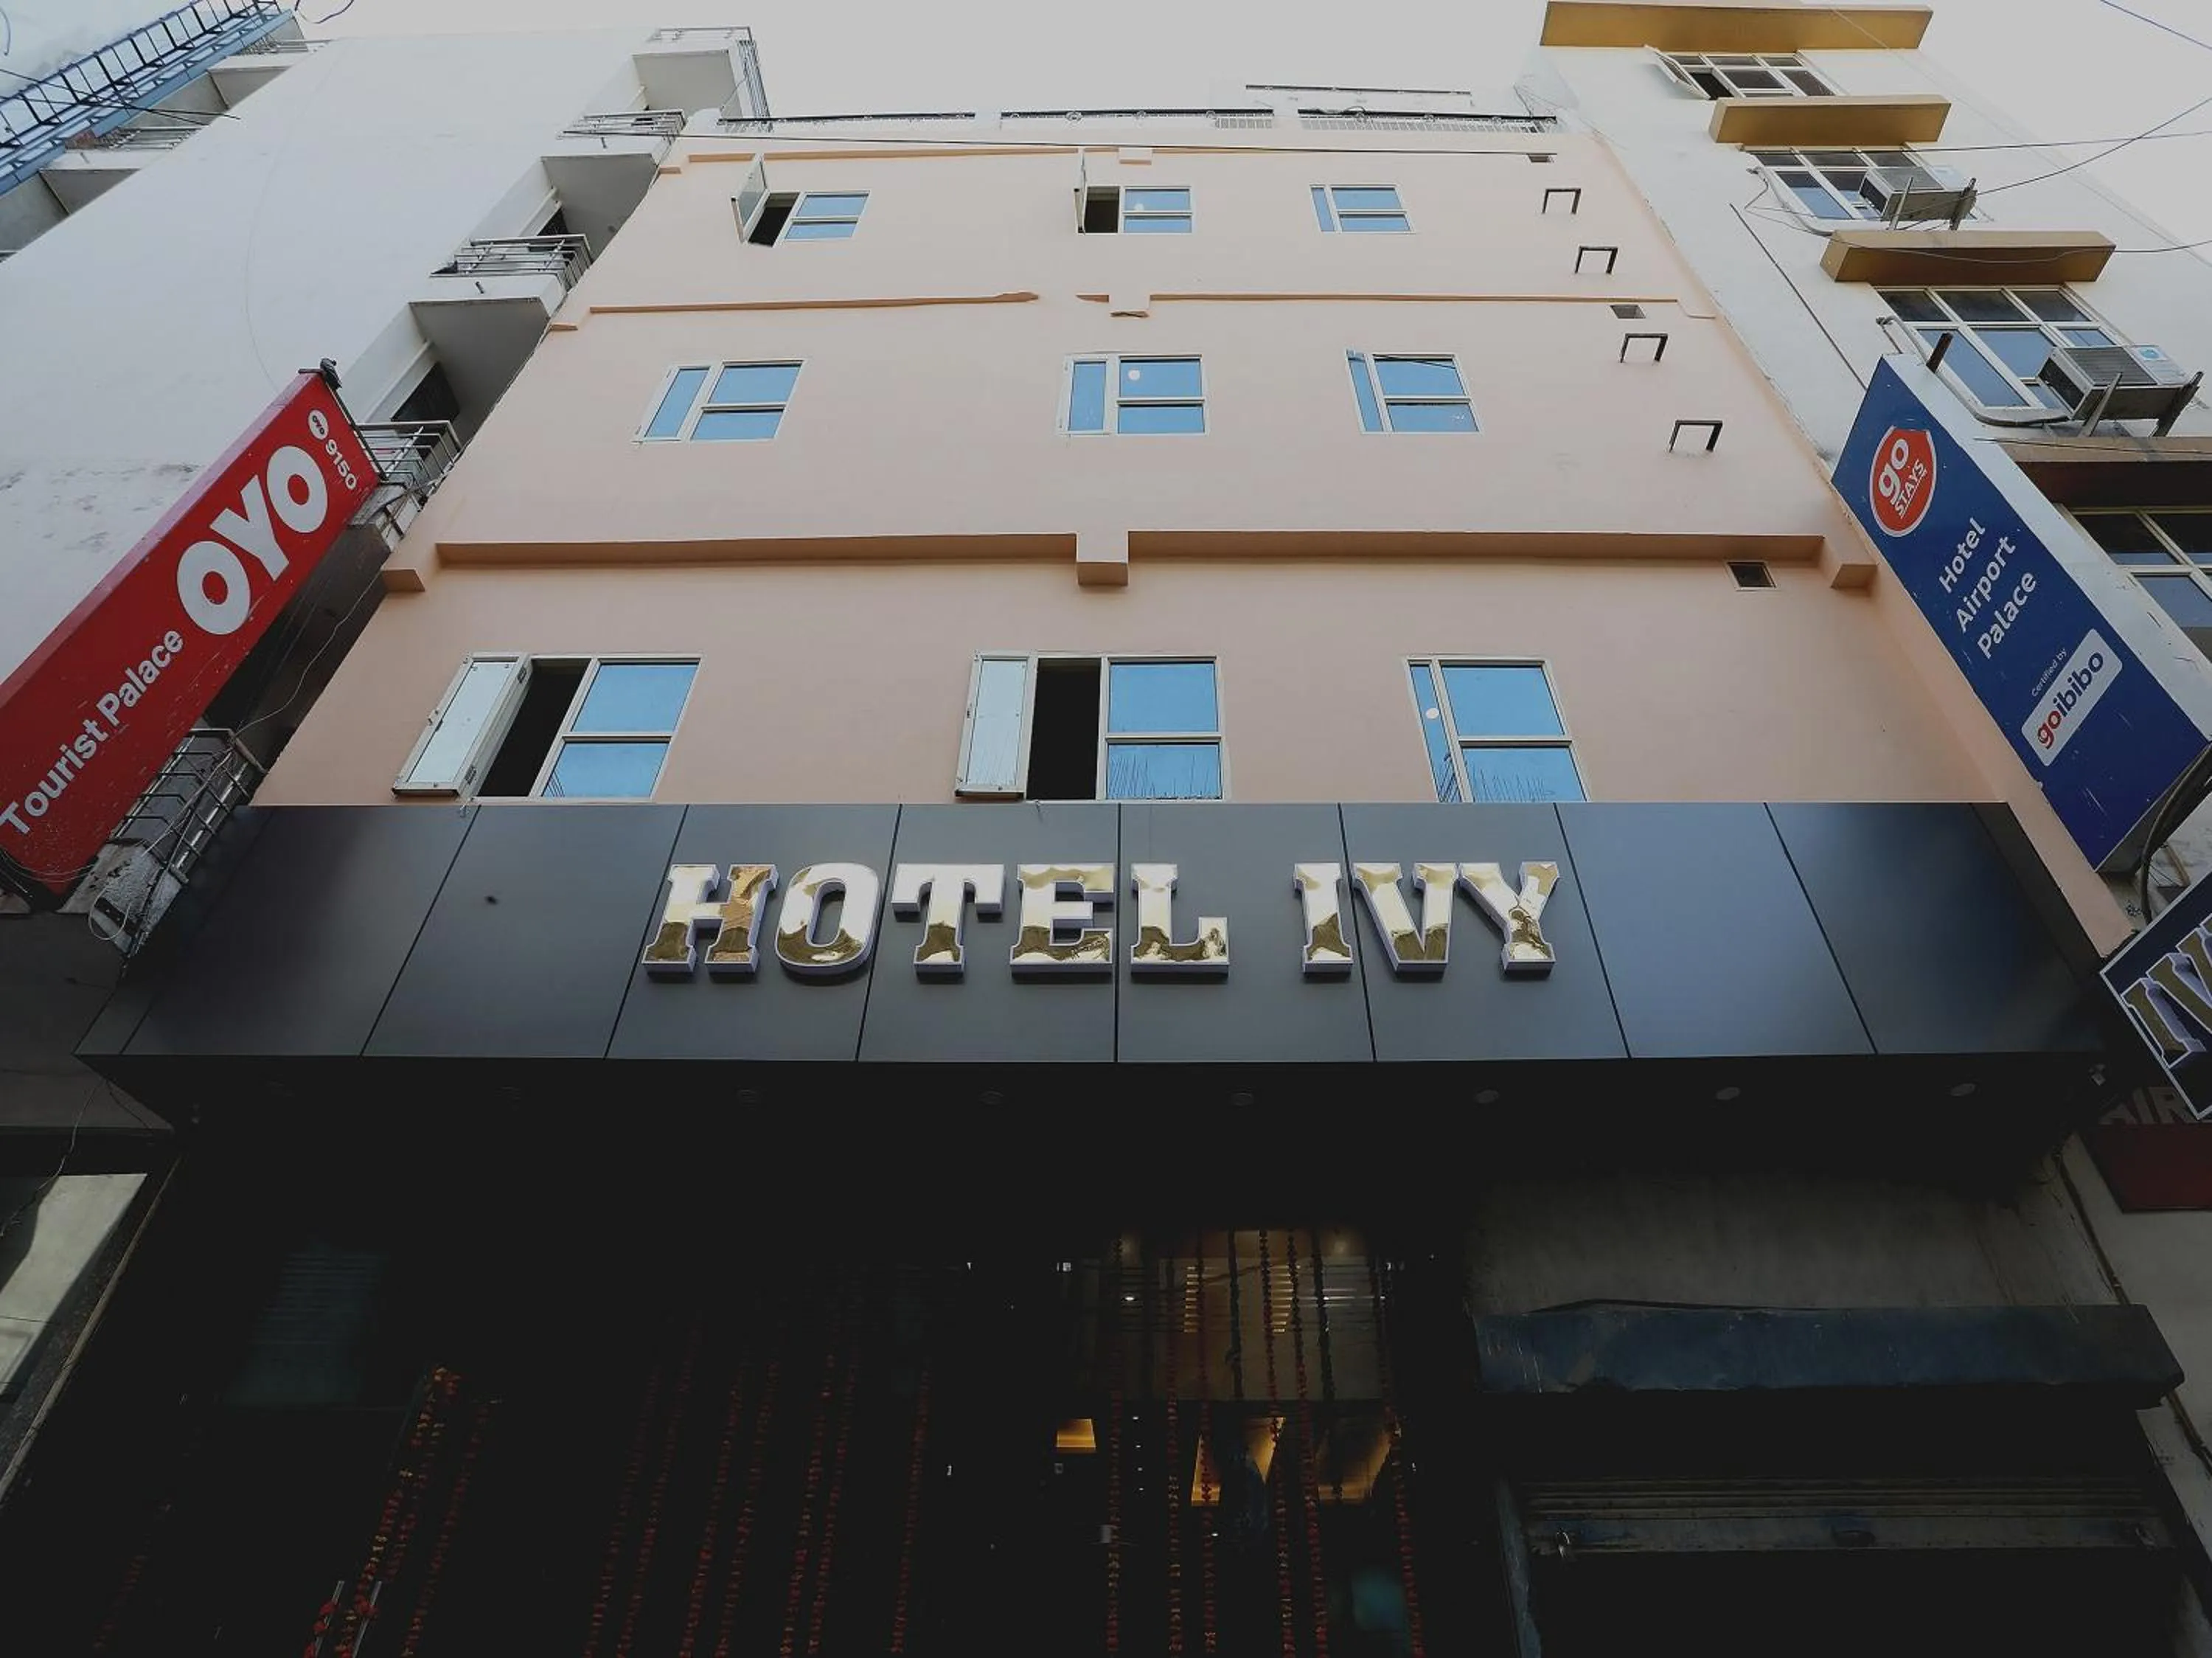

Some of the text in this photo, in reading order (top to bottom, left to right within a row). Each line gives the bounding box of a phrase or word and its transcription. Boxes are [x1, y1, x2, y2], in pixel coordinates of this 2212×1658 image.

[325, 439, 357, 490] 9150
[1879, 438, 1909, 505] go
[1894, 458, 1926, 517] STAYS
[176, 445, 328, 635] OYO
[1938, 517, 1986, 593] Hotel
[1956, 536, 2016, 633] Airport
[1977, 572, 2037, 659] Palace
[2056, 647, 2067, 661] by
[0, 631, 184, 834] Tourist Palace
[2037, 652, 2104, 749] goibibo
[641, 861, 1561, 975] HOTEL IVY
[2121, 913, 2212, 1068] IV
